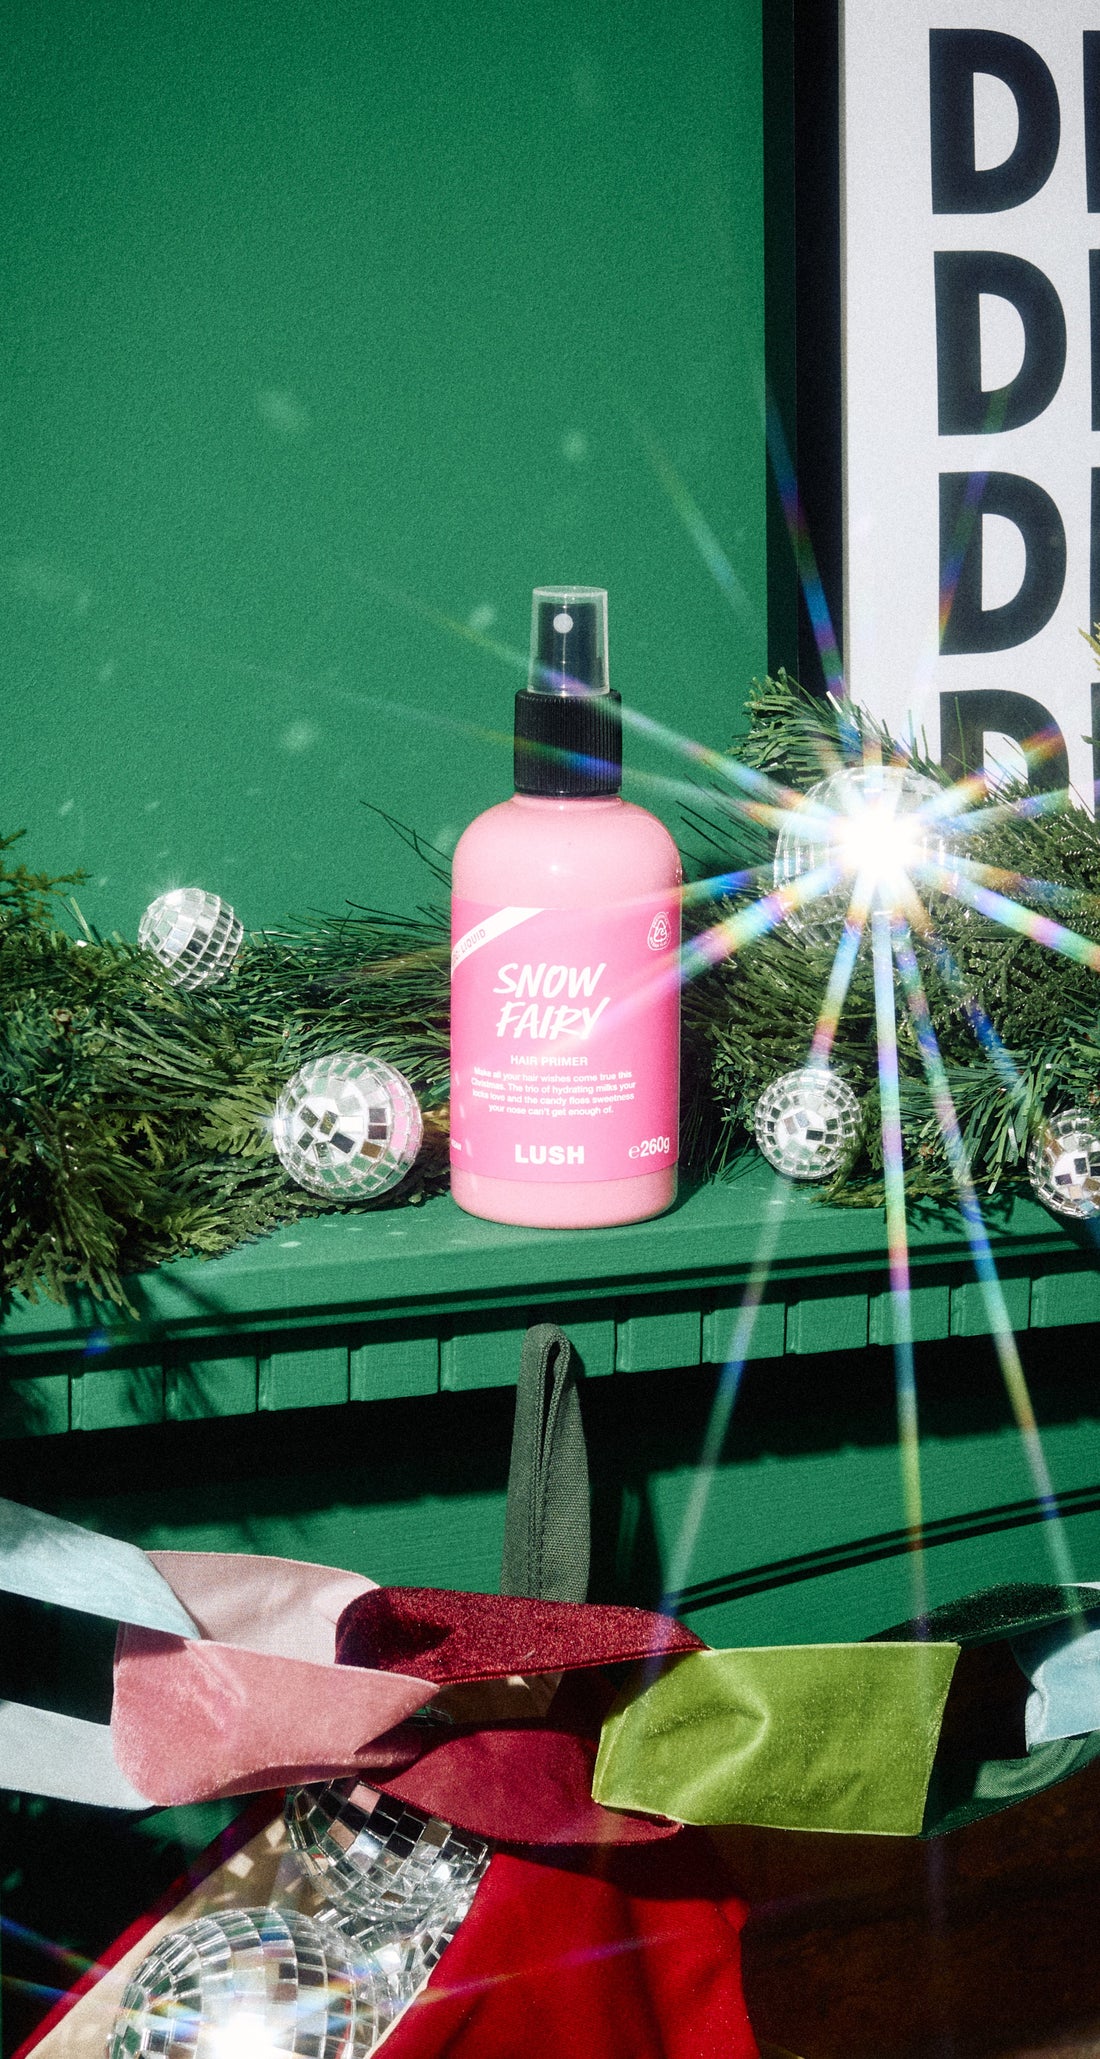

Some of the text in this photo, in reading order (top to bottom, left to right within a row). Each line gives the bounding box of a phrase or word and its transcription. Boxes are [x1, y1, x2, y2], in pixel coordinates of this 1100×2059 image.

[939, 467, 1100, 656] D
[460, 929, 486, 953] LIQUID
[493, 962, 607, 999] SNOW
[496, 997, 610, 1040] FAIRY
[510, 1055, 588, 1067] HAIR PRIMER
[474, 1066, 492, 1078] Make
[503, 1073, 520, 1082] your
[522, 1074, 538, 1082] hair
[540, 1074, 571, 1083] wishes
[600, 1073, 616, 1081] true
[618, 1071, 632, 1079] this
[508, 1083, 523, 1092] The
[525, 1084, 539, 1092] trio
[541, 1085, 551, 1093] of
[552, 1085, 594, 1095] hydrating
[595, 1083, 617, 1092] milks
[619, 1082, 636, 1092] your
[490, 1092, 506, 1101] love
[507, 1095, 522, 1103] and
[524, 1096, 538, 1104] the
[540, 1096, 567, 1106] candy
[569, 1096, 590, 1104] floss
[592, 1093, 634, 1104] sweetness
[489, 1104, 614, 1117] your nose can't get enough of.
[514, 1144, 585, 1165] LUSH
